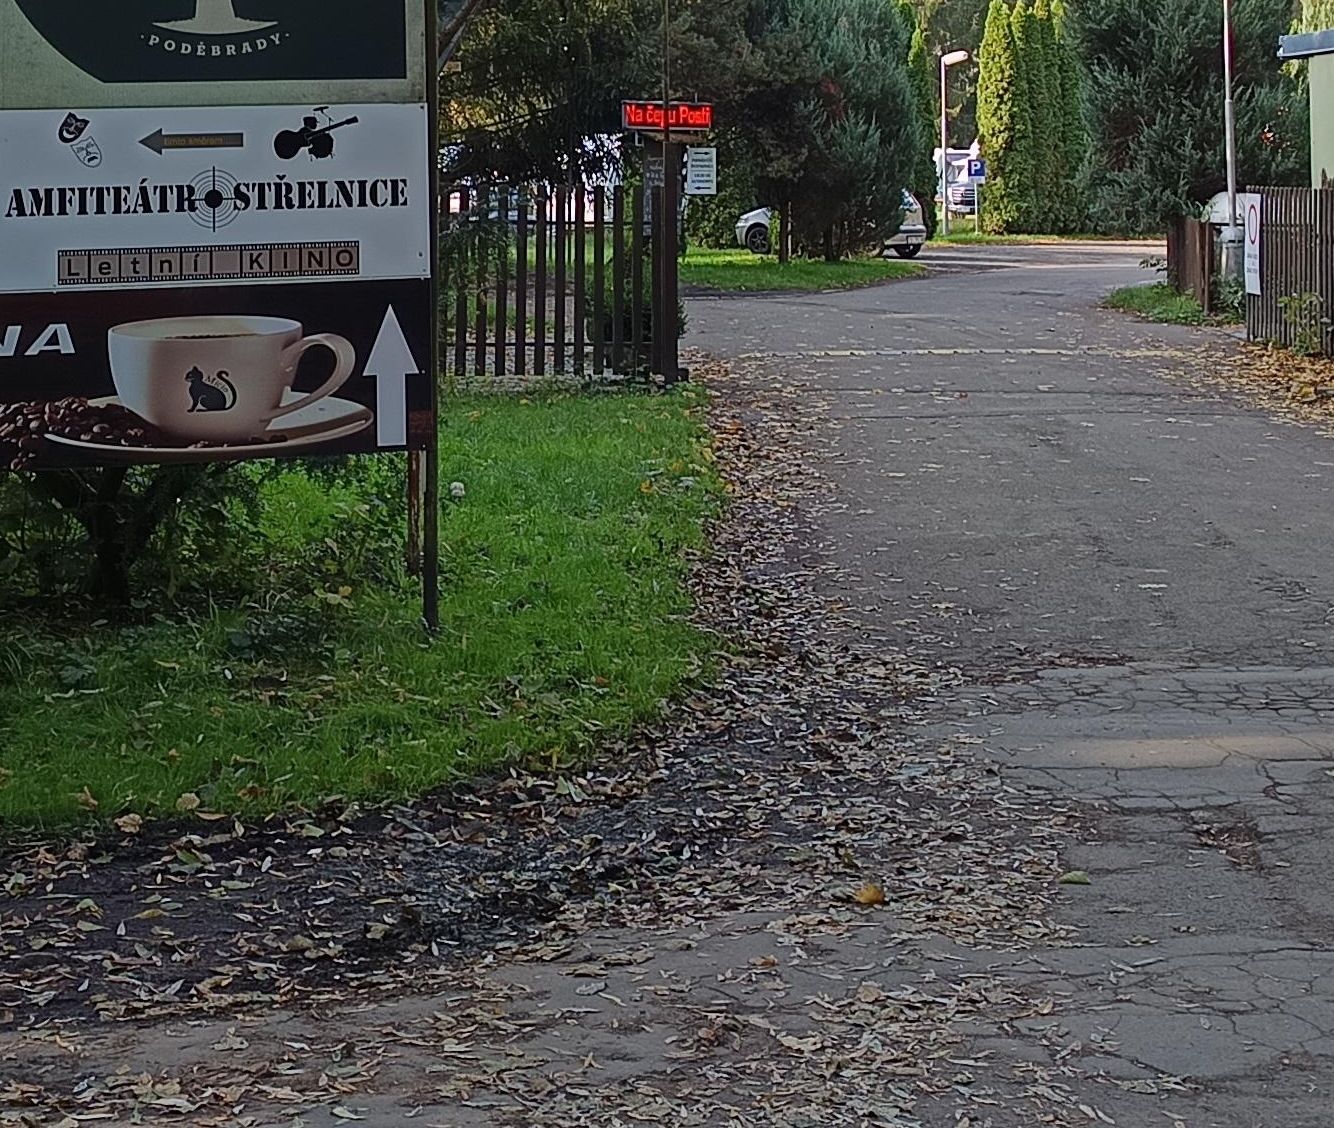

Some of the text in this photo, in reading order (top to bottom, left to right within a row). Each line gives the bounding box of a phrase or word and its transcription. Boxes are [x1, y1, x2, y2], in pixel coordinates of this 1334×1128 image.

[148, 33, 282, 57] PODĚBRADY
[626, 104, 643, 123] Na
[4, 174, 409, 218] AMFITEÁTR STŘELNICE
[66, 248, 354, 277] Letní KINO
